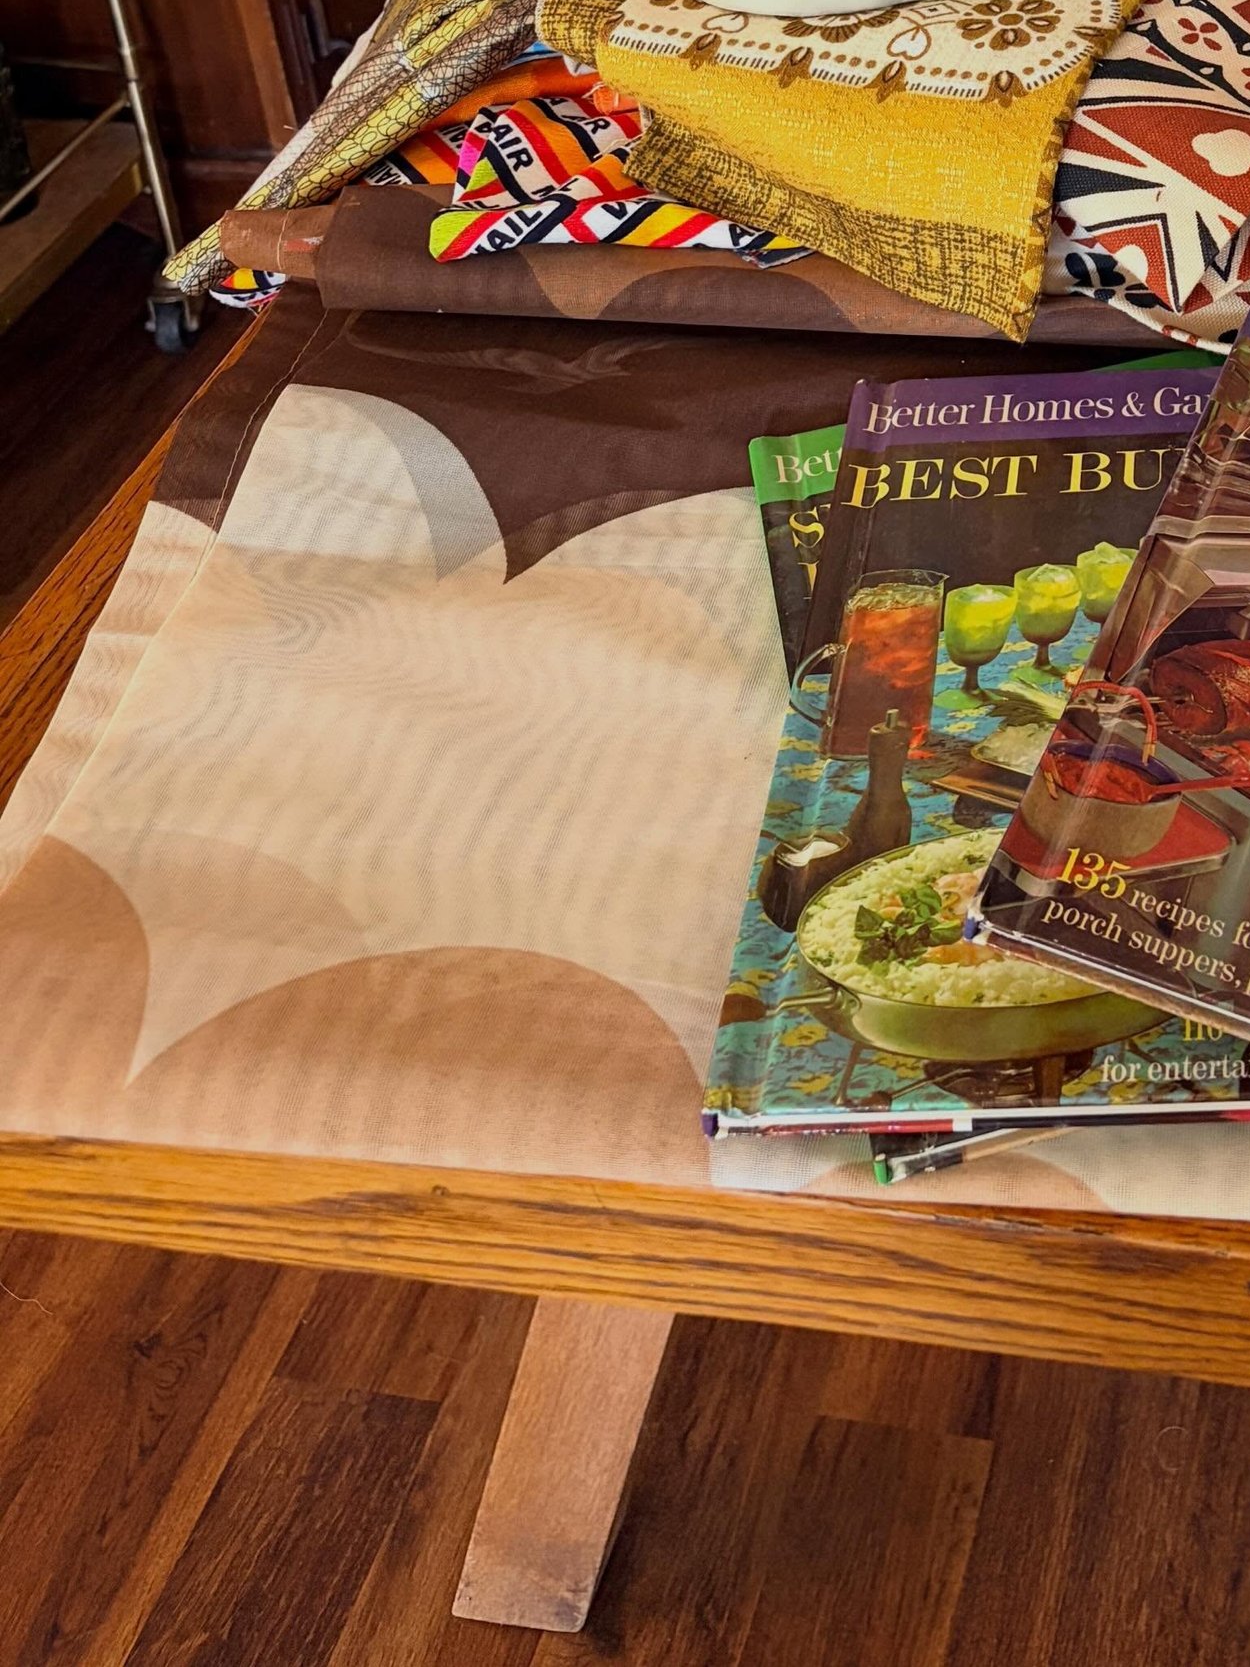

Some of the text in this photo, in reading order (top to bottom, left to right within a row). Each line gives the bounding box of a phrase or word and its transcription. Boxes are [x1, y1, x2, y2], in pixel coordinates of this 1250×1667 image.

[493, 123, 534, 172] AIR
[862, 387, 1211, 434] Better Homes & Ga
[841, 448, 1187, 509] BEST BU
[1056, 847, 1132, 900] 135
[1130, 887, 1226, 938] recipes
[1042, 899, 1123, 943] porch
[1128, 930, 1241, 989] suppers,
[1100, 1056, 1141, 1083] for
